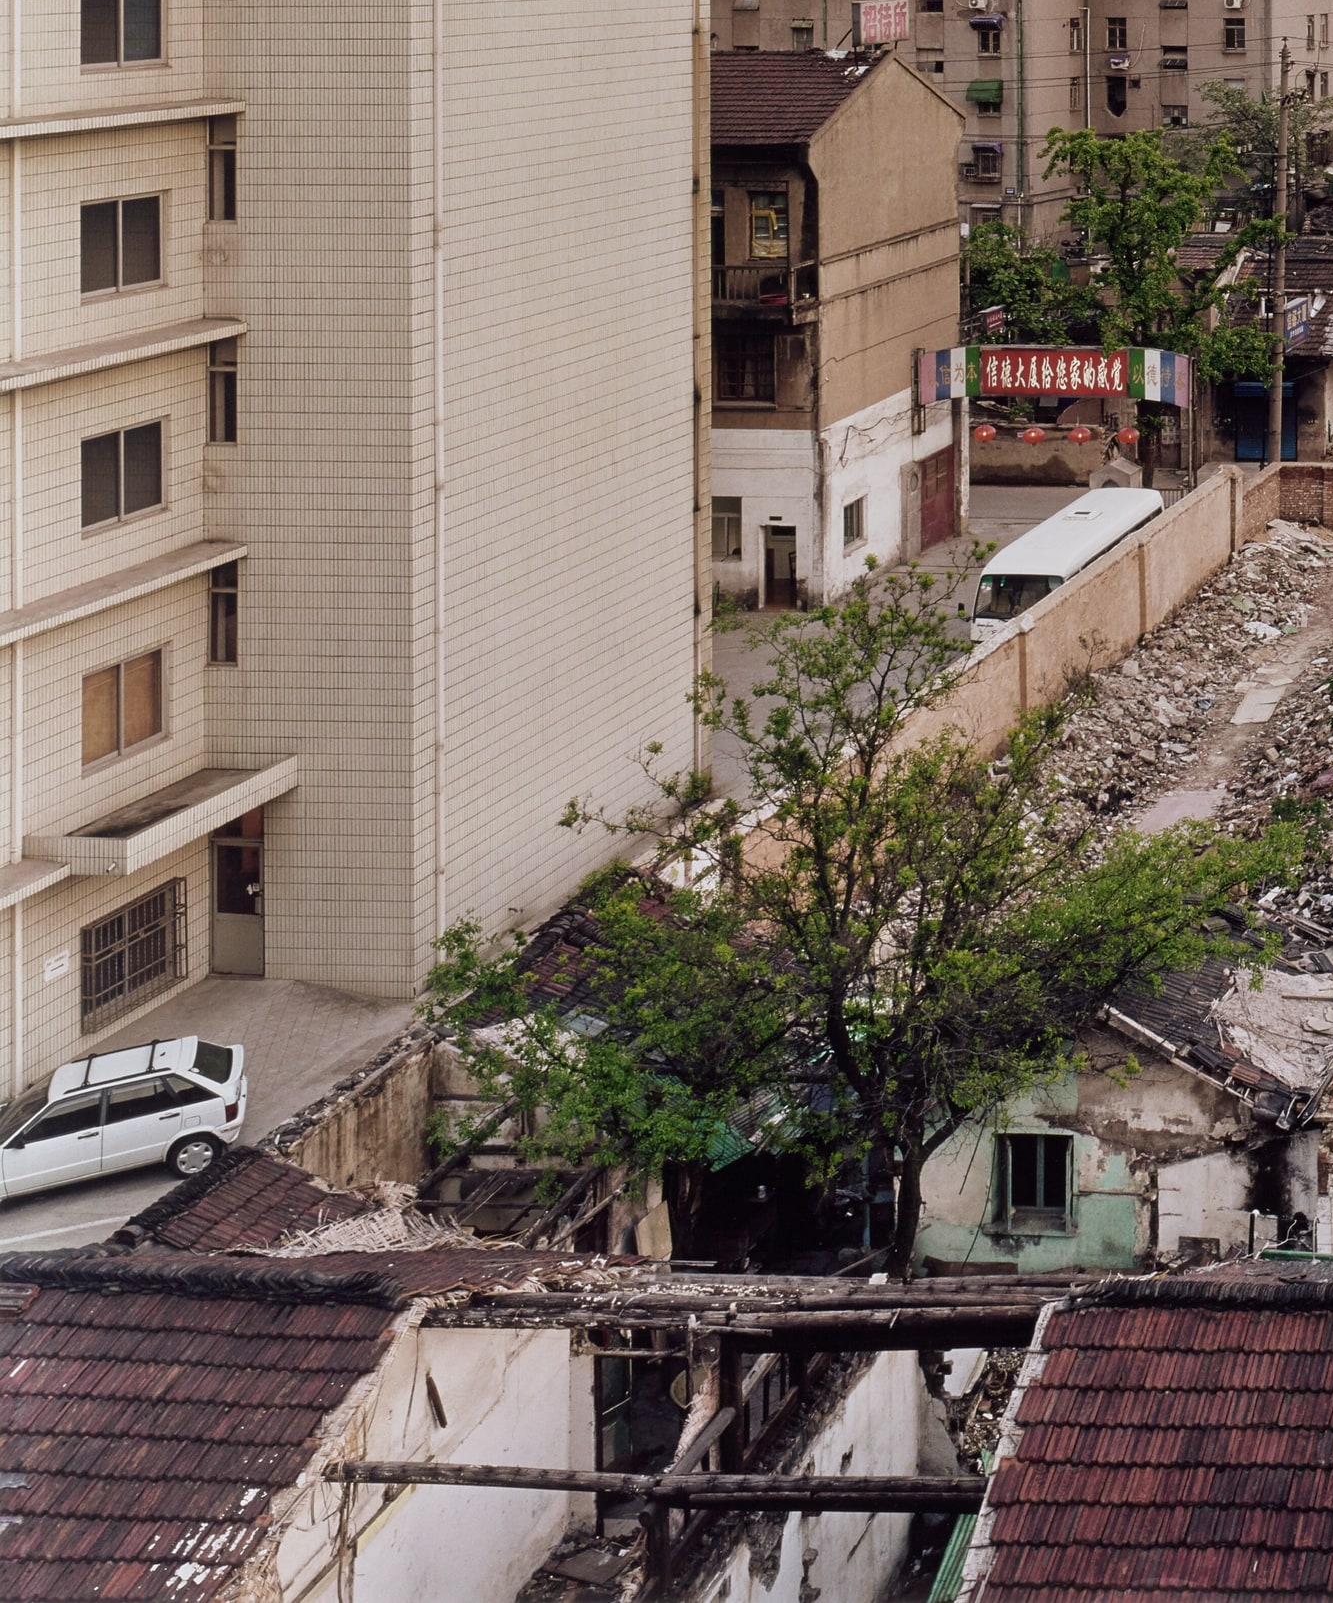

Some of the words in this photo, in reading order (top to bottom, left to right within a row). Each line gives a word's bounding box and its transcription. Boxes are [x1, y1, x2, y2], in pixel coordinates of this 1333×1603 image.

[862, 1, 907, 44] 招待所
[986, 355, 1123, 391] 信德大厦给您家的感觉
